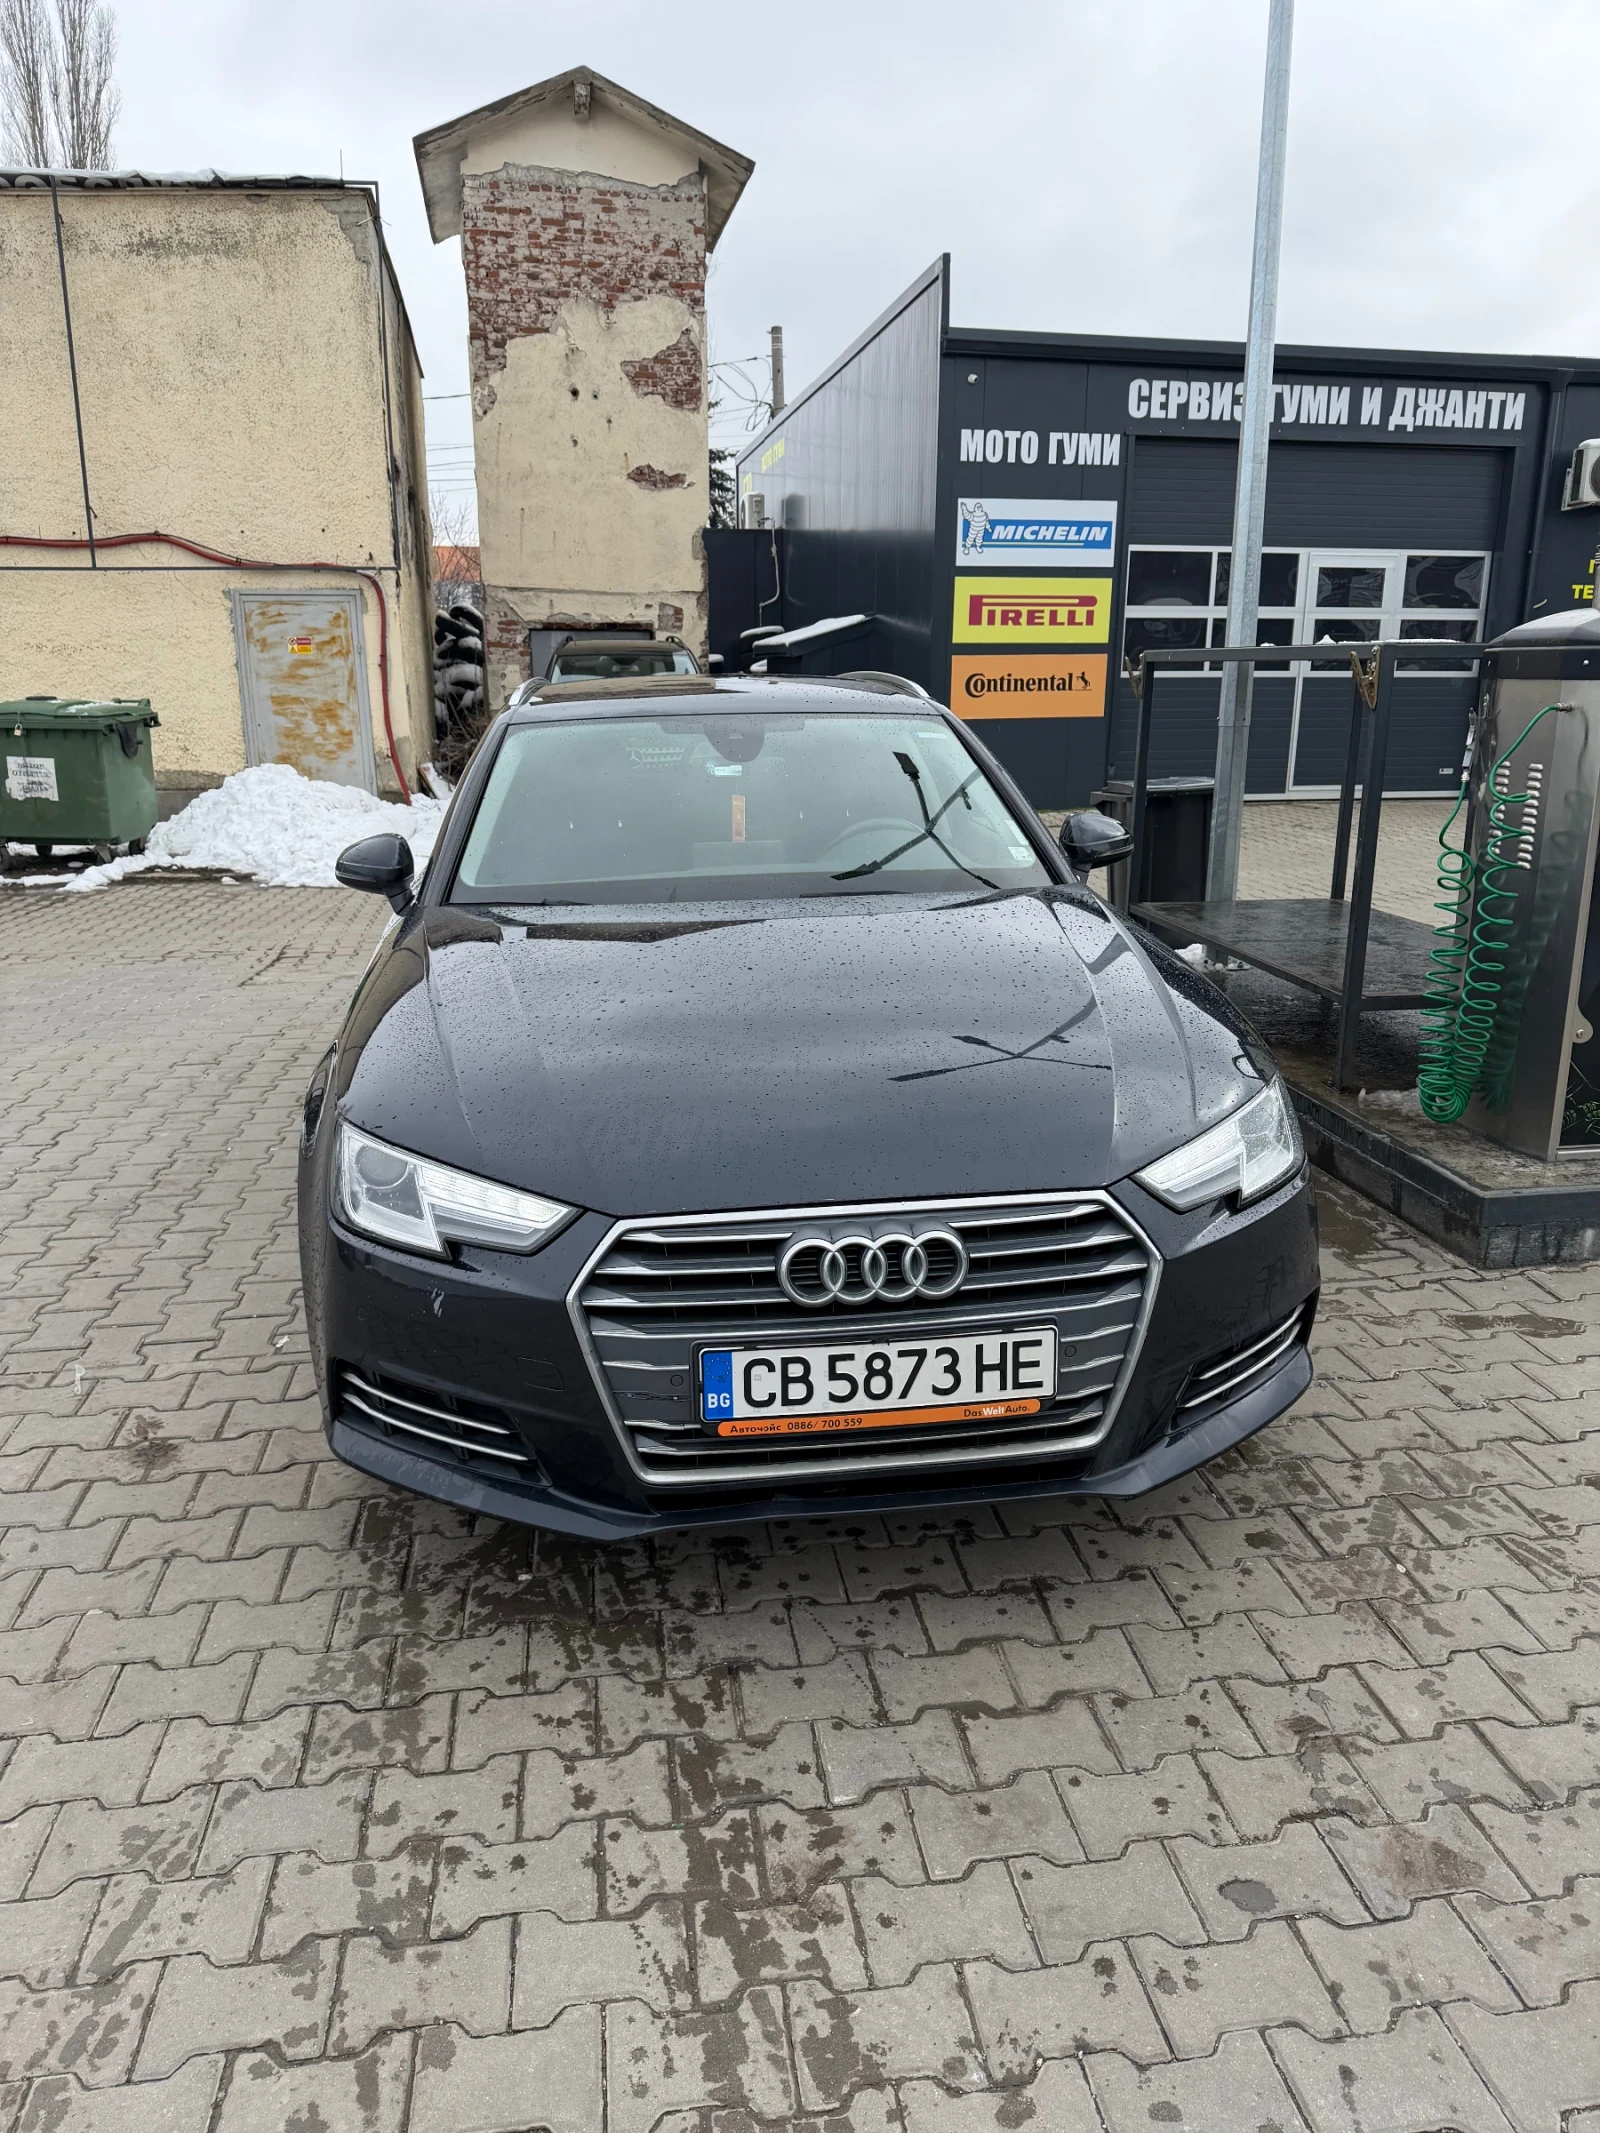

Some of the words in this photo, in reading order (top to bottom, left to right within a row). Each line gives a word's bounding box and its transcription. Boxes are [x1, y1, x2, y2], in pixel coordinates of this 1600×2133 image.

[1360, 386, 1383, 426] И
[1388, 386, 1526, 432] ДЖАНТИ
[960, 429, 1039, 464] МОТО
[1048, 432, 1121, 466] ГУМИ
[991, 525, 1108, 541] MICHELIN
[968, 594, 1098, 626] PIRELLI
[964, 672, 1073, 698] Continental
[743, 1356, 814, 1408] CB
[828, 1346, 962, 1404] 5873
[975, 1339, 1044, 1394] HE
[707, 1392, 730, 1409] BG
[821, 1420, 841, 1429] 700
[843, 1417, 863, 1427] 559
